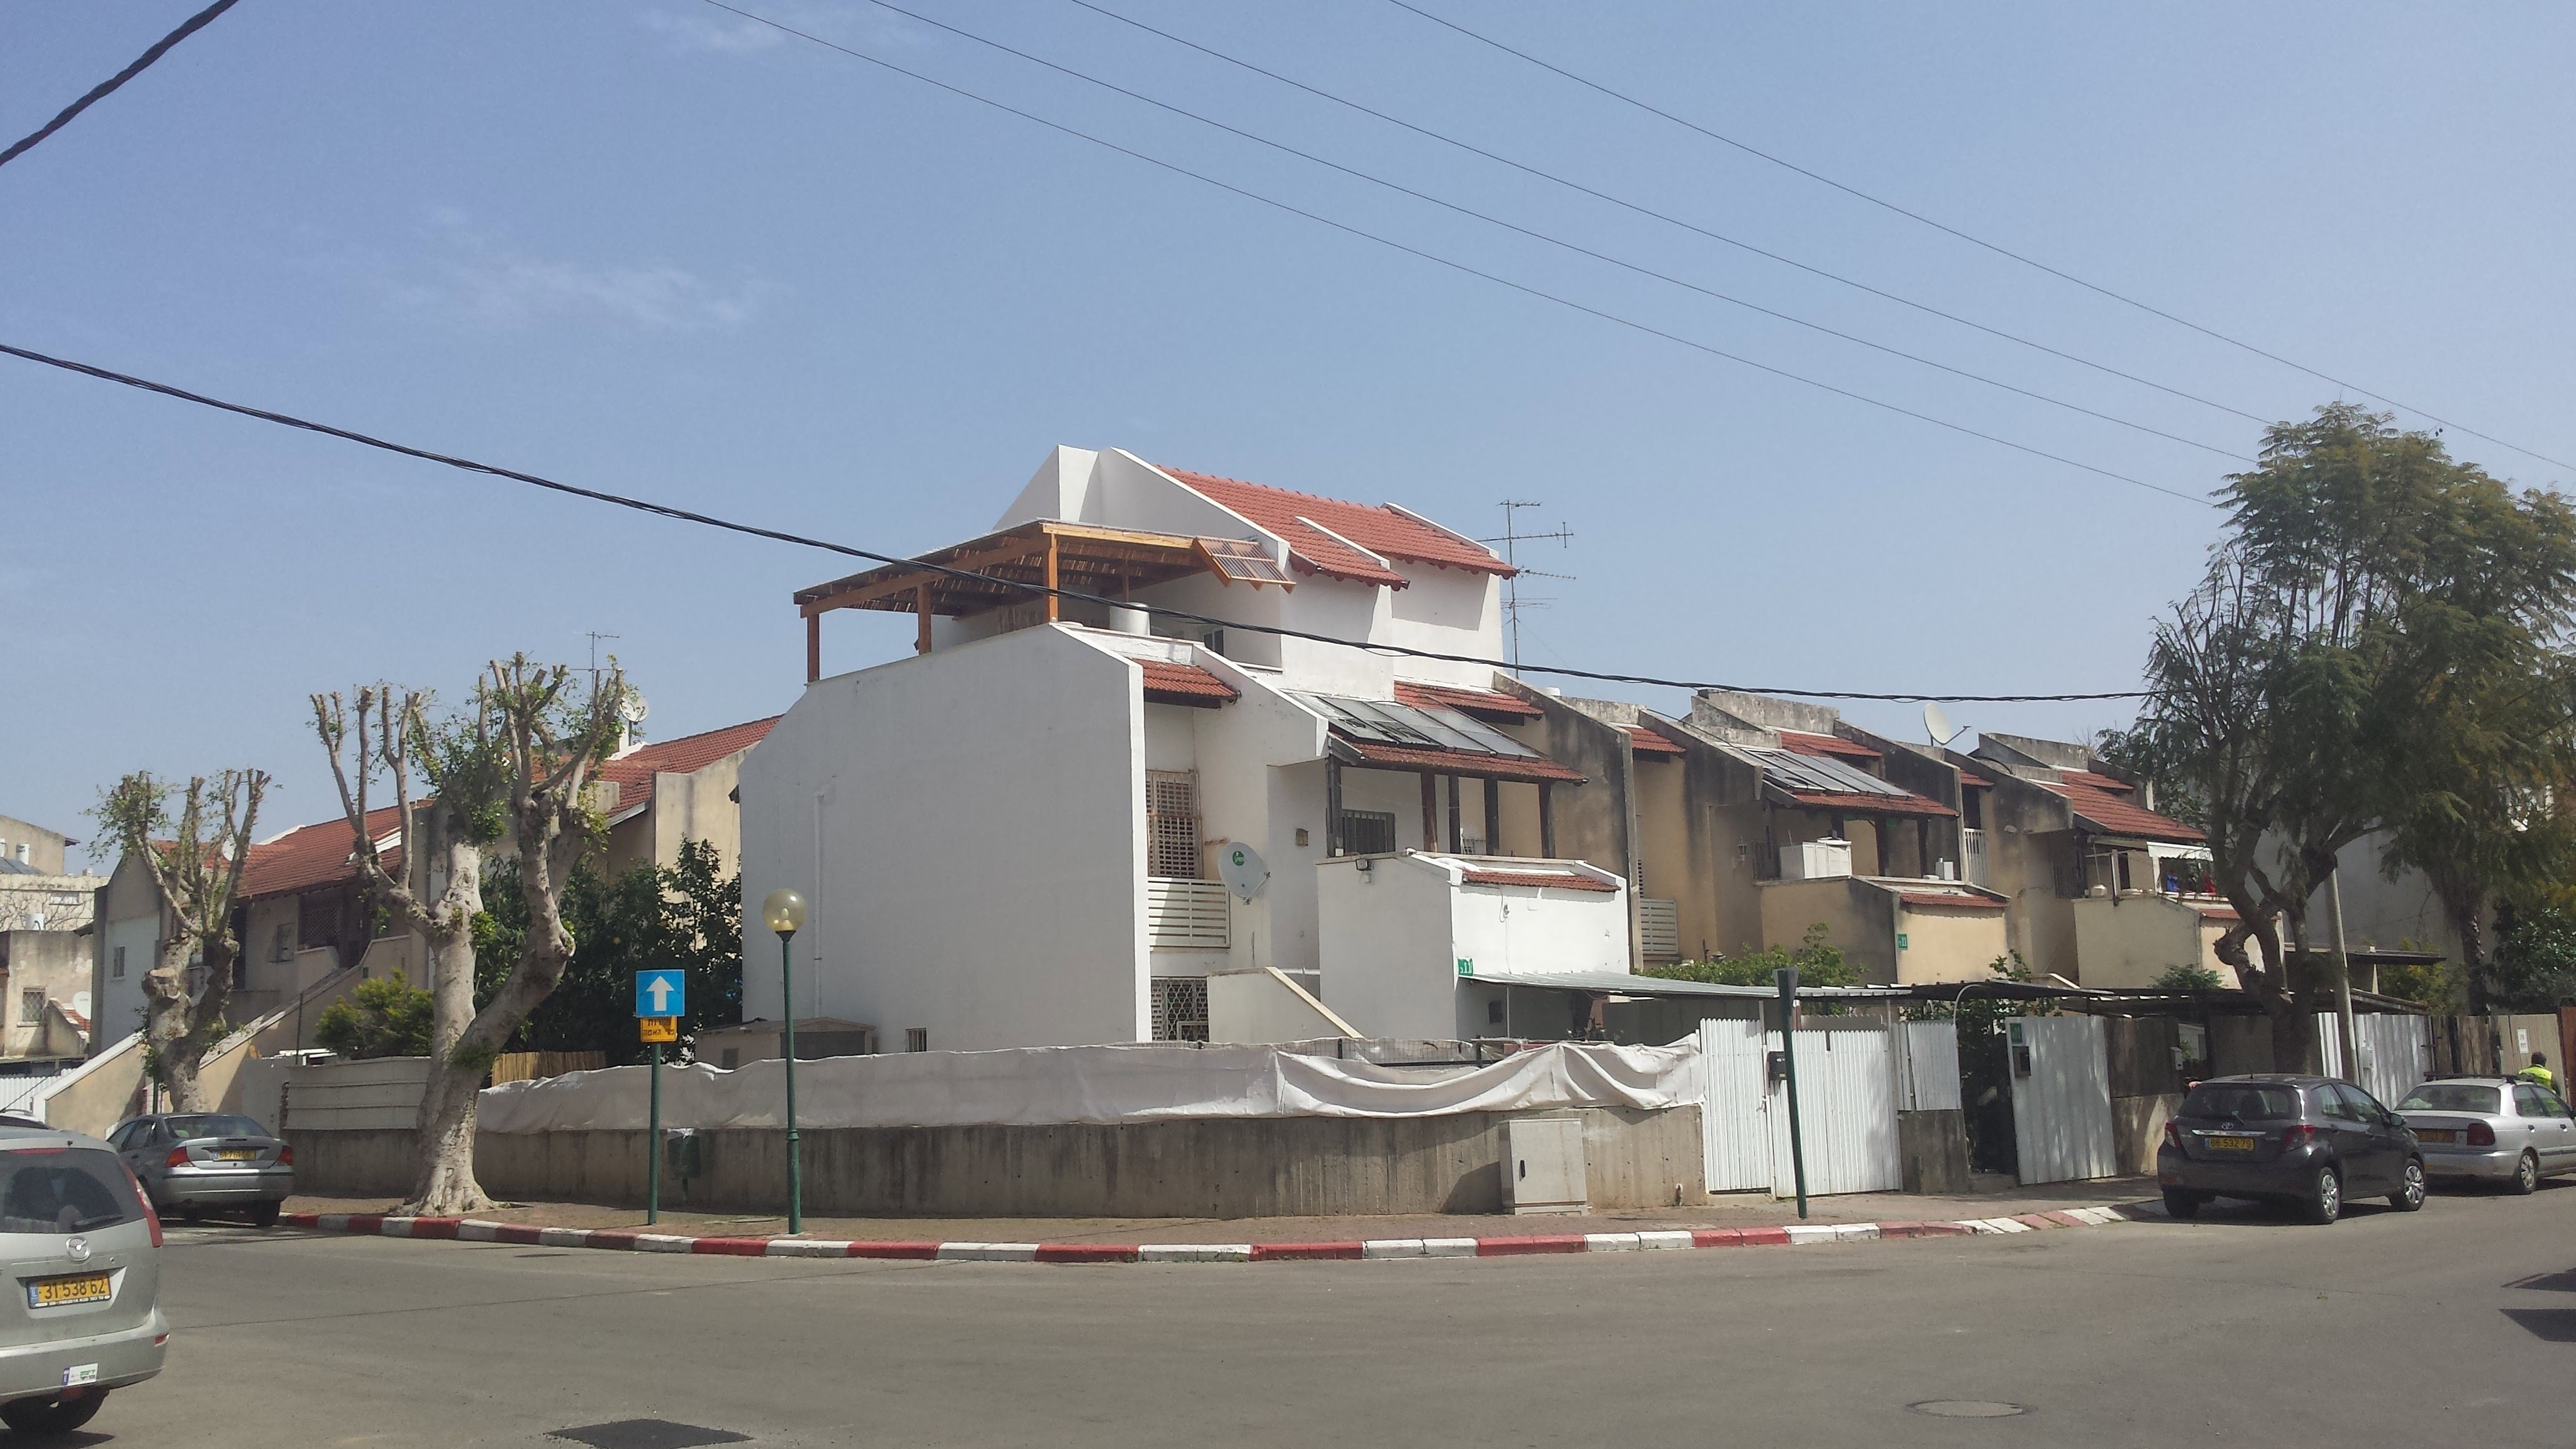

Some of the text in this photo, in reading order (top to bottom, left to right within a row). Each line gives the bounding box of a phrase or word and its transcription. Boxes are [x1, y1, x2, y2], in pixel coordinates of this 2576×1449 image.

[44, 1282, 59, 1299] 31
[62, 1281, 87, 1297] 538
[90, 1279, 105, 1294] 62
